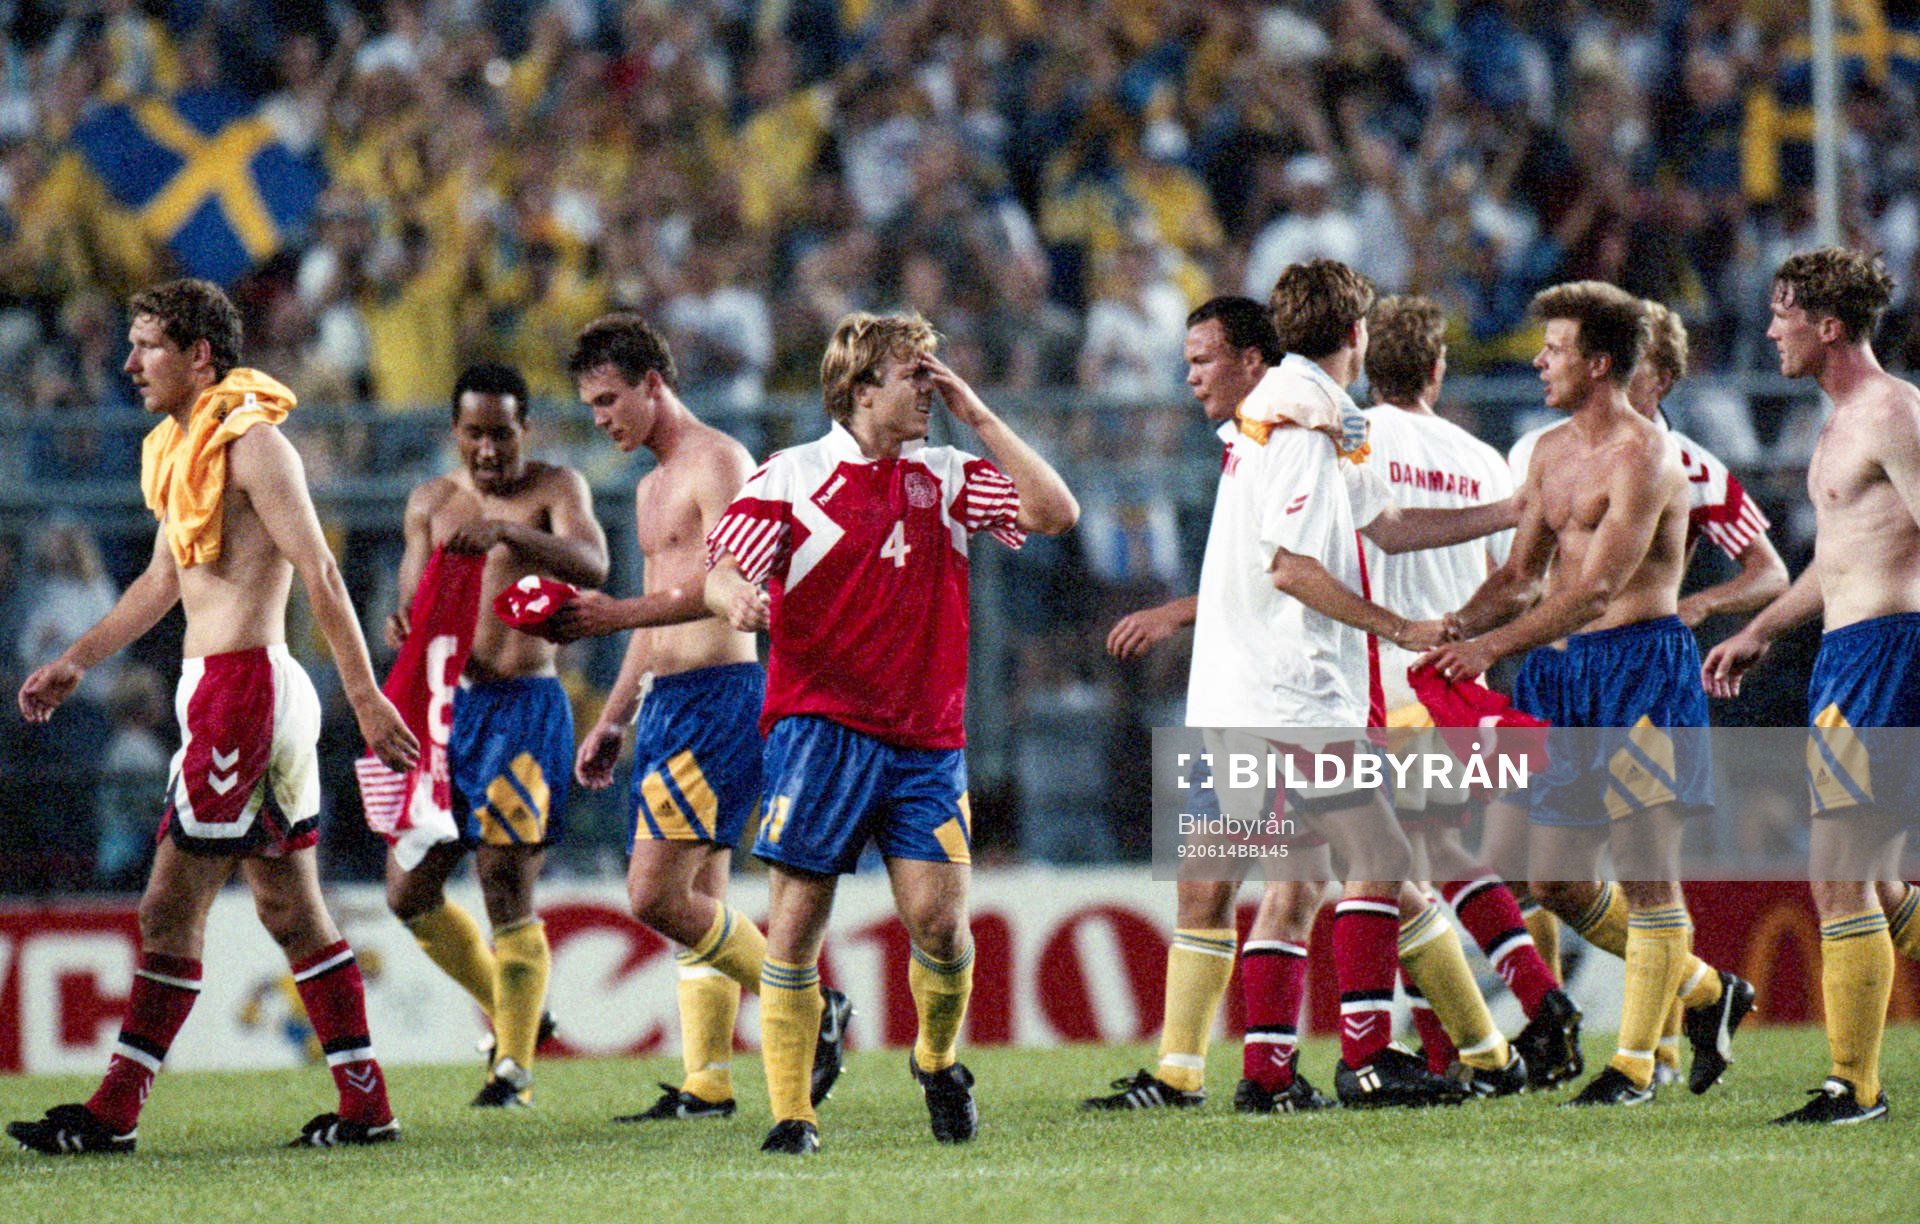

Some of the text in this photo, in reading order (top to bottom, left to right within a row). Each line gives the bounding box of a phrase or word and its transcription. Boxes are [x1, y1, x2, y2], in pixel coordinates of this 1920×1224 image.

[1388, 461, 1481, 501] DANMARK
[880, 519, 912, 569] 4
[0, 930, 136, 1074] C
[478, 896, 1352, 1060] Cno
